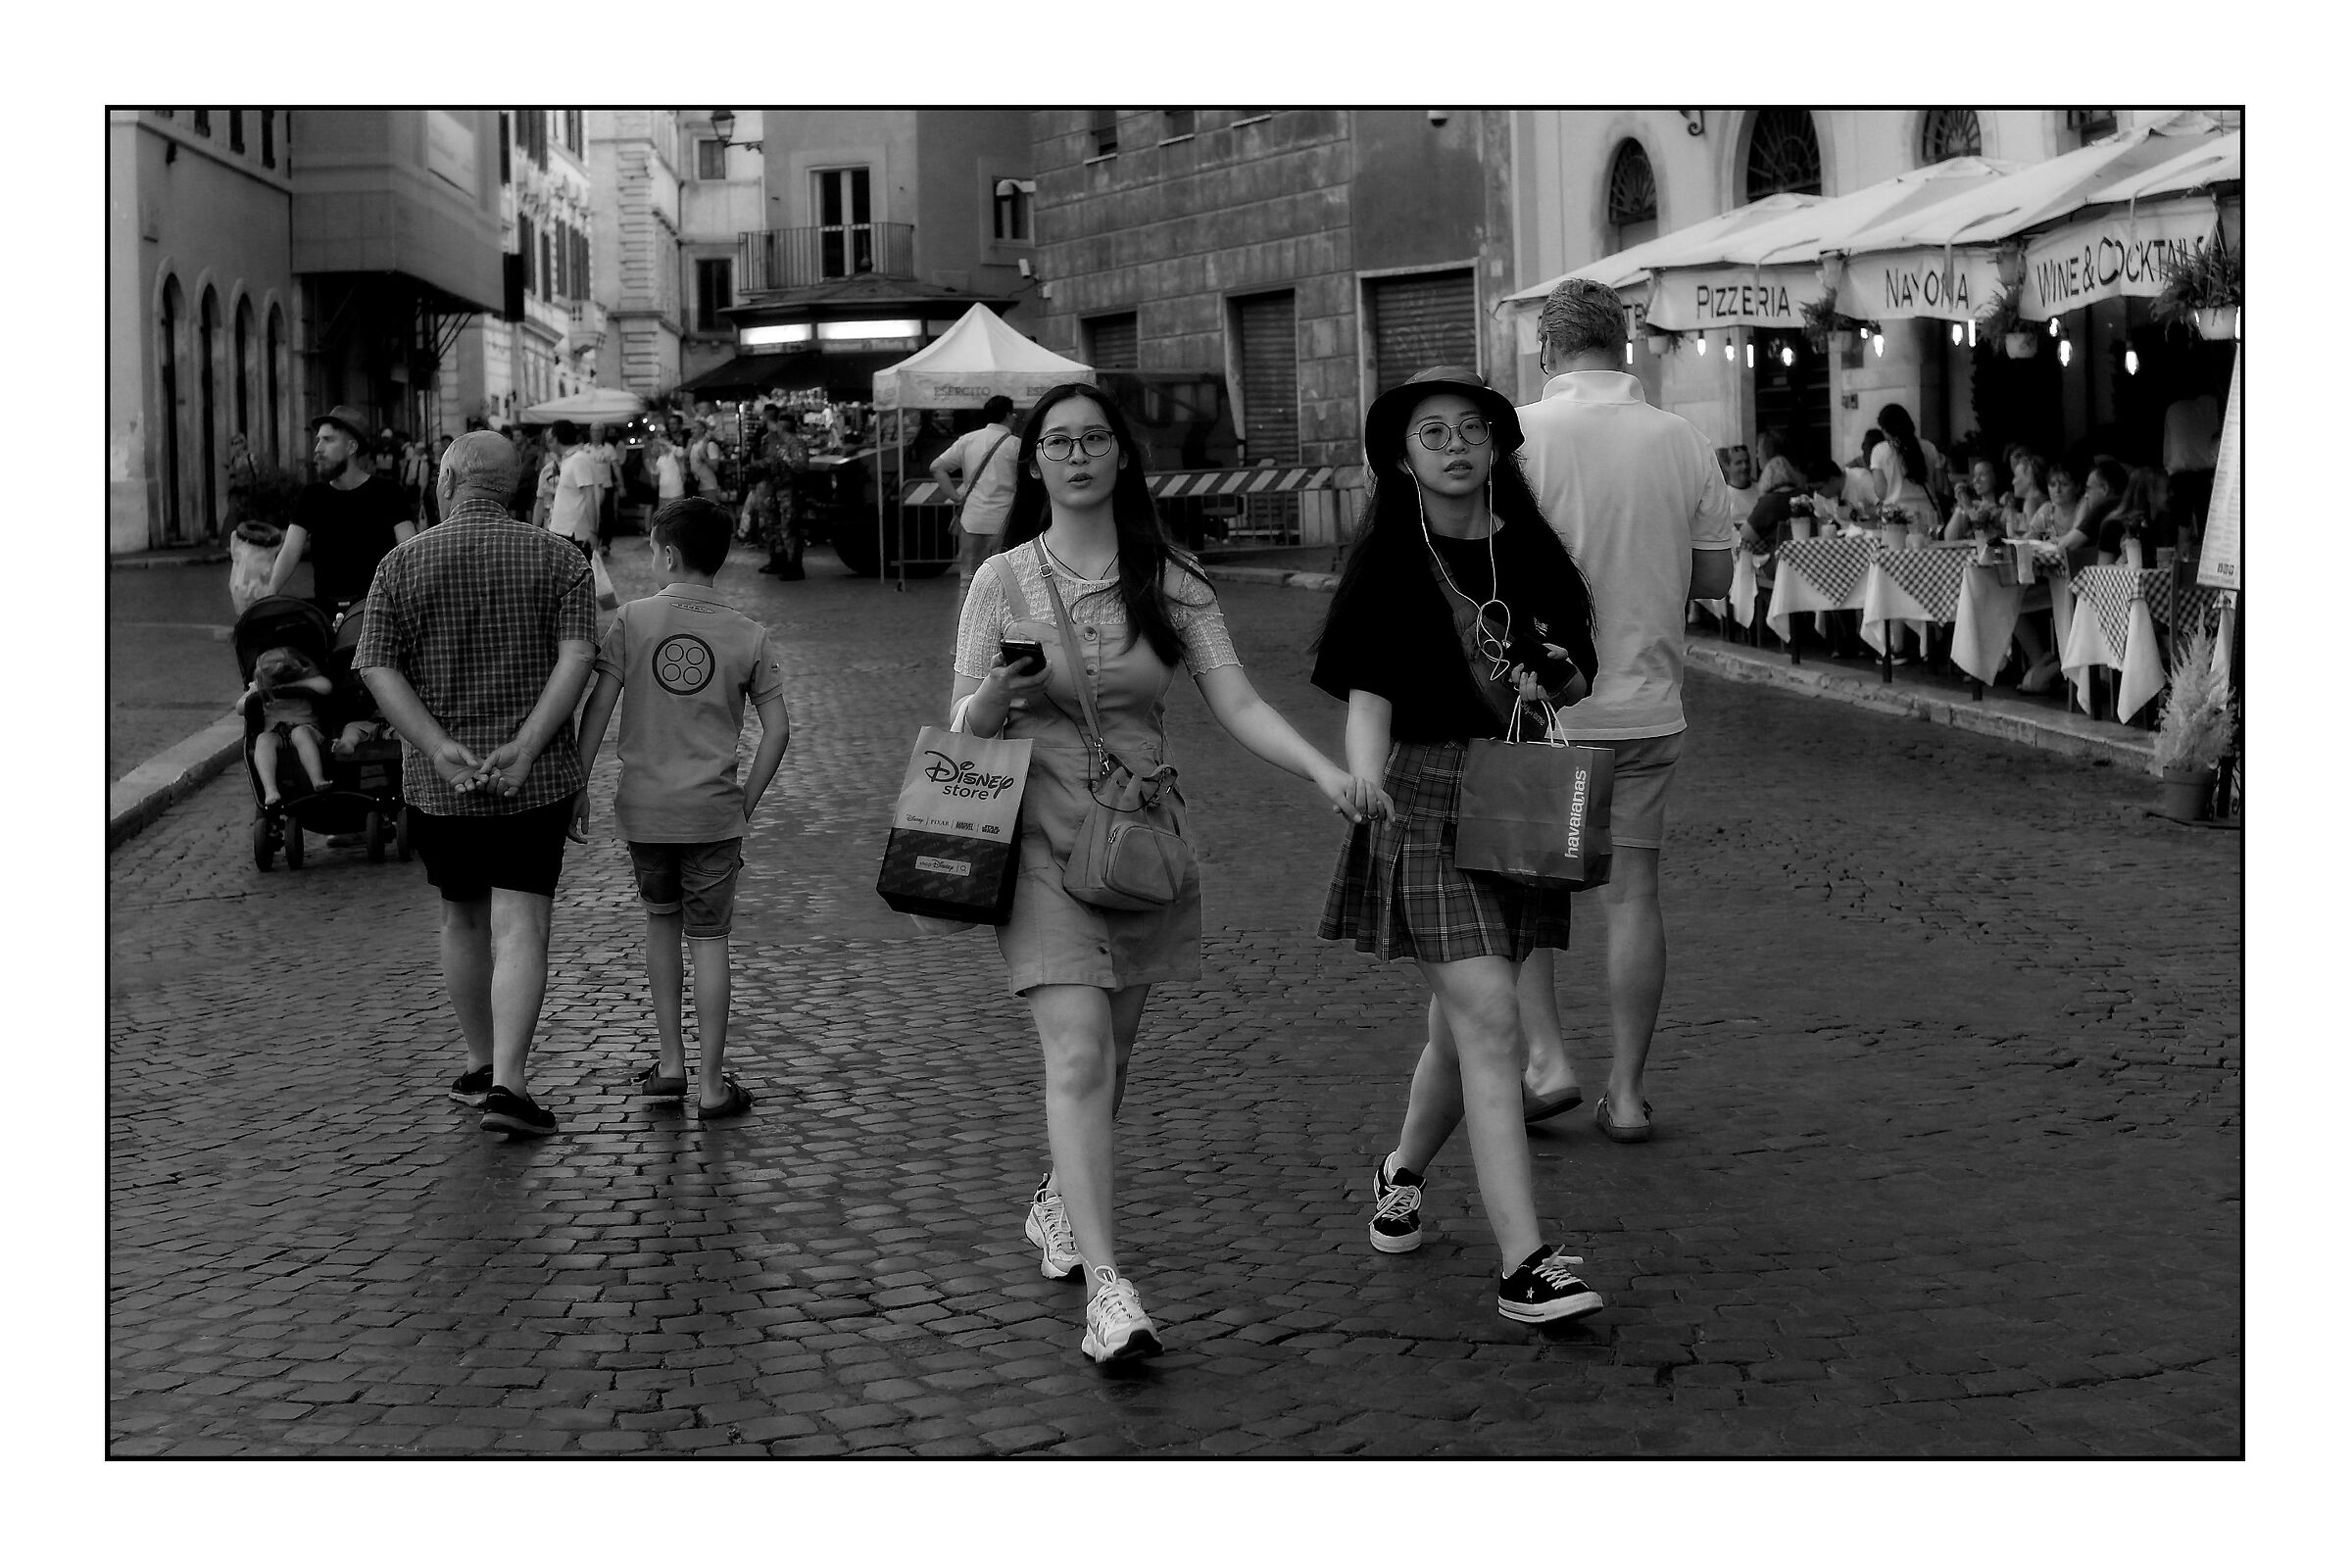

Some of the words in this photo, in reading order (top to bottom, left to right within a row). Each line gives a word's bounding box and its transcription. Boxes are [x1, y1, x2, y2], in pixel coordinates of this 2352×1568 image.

[2037, 257, 2080, 307] WINE
[2082, 246, 2094, 292] &
[1697, 285, 1790, 319] PIZZERIA
[934, 384, 991, 398] ESERCITO
[942, 784, 989, 800] store
[1564, 769, 1587, 858] havaianas
